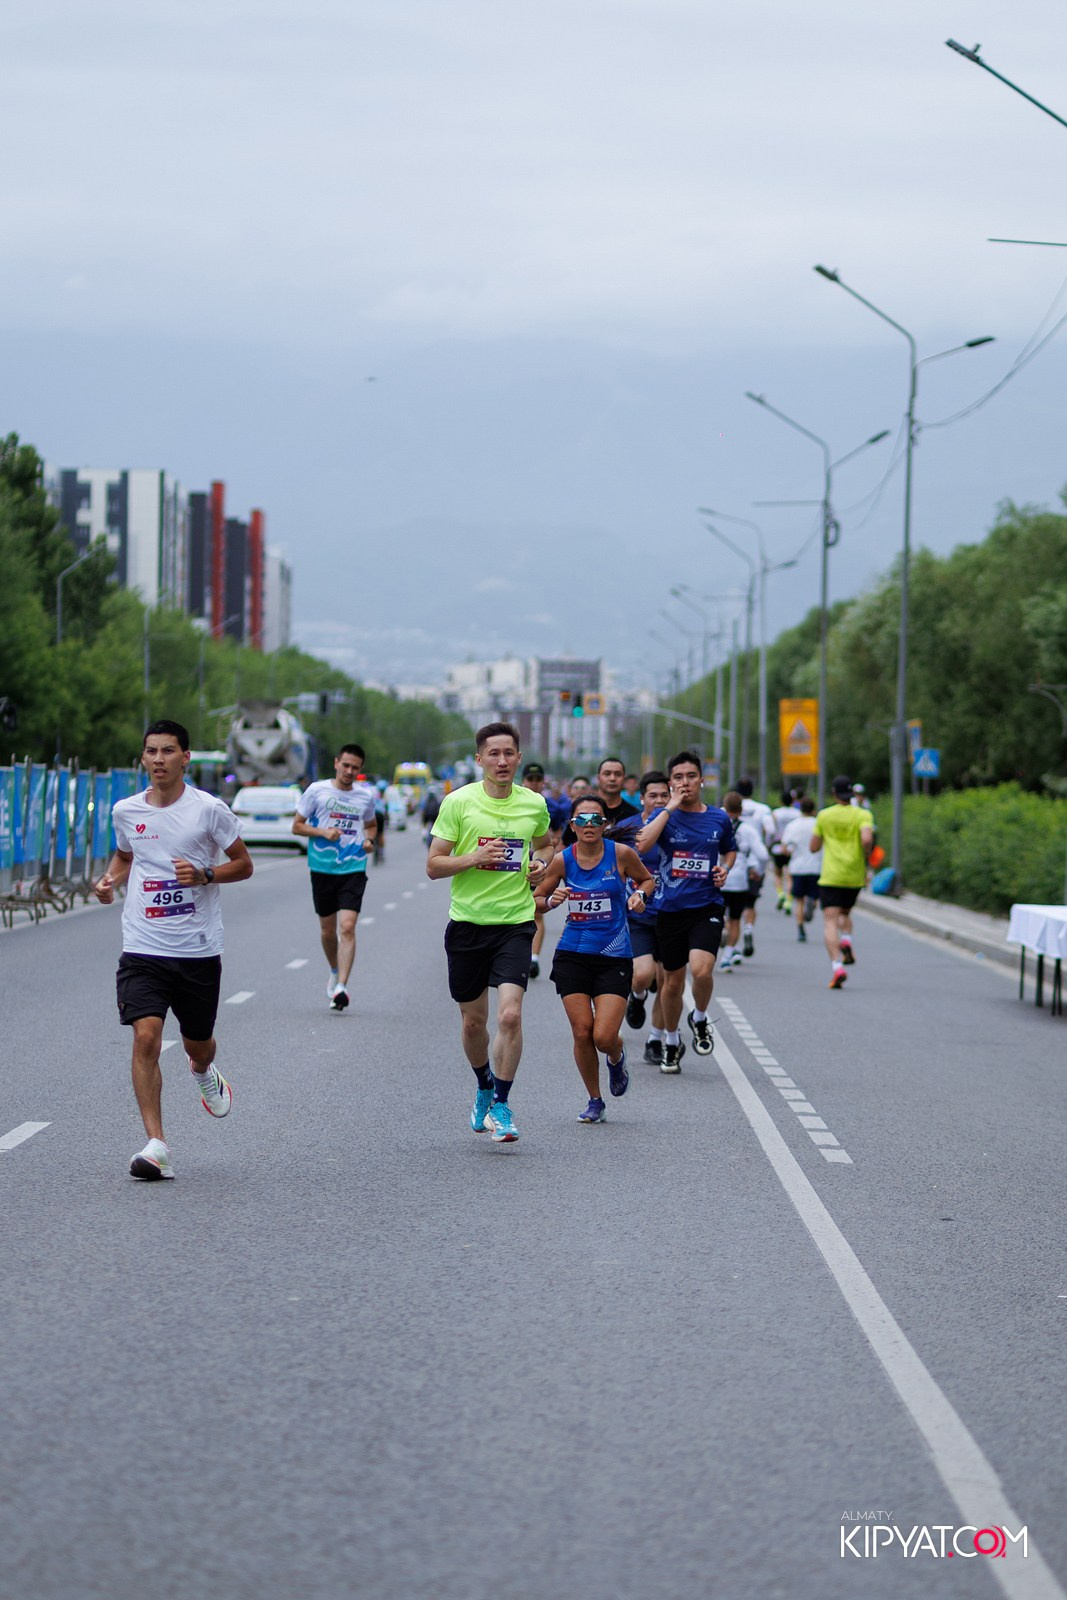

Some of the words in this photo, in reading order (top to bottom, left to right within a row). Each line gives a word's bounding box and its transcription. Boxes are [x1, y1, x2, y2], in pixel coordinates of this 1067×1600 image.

[334, 819, 353, 828] 258
[679, 860, 703, 870] 295
[152, 890, 184, 906] 496
[578, 900, 602, 912] 143
